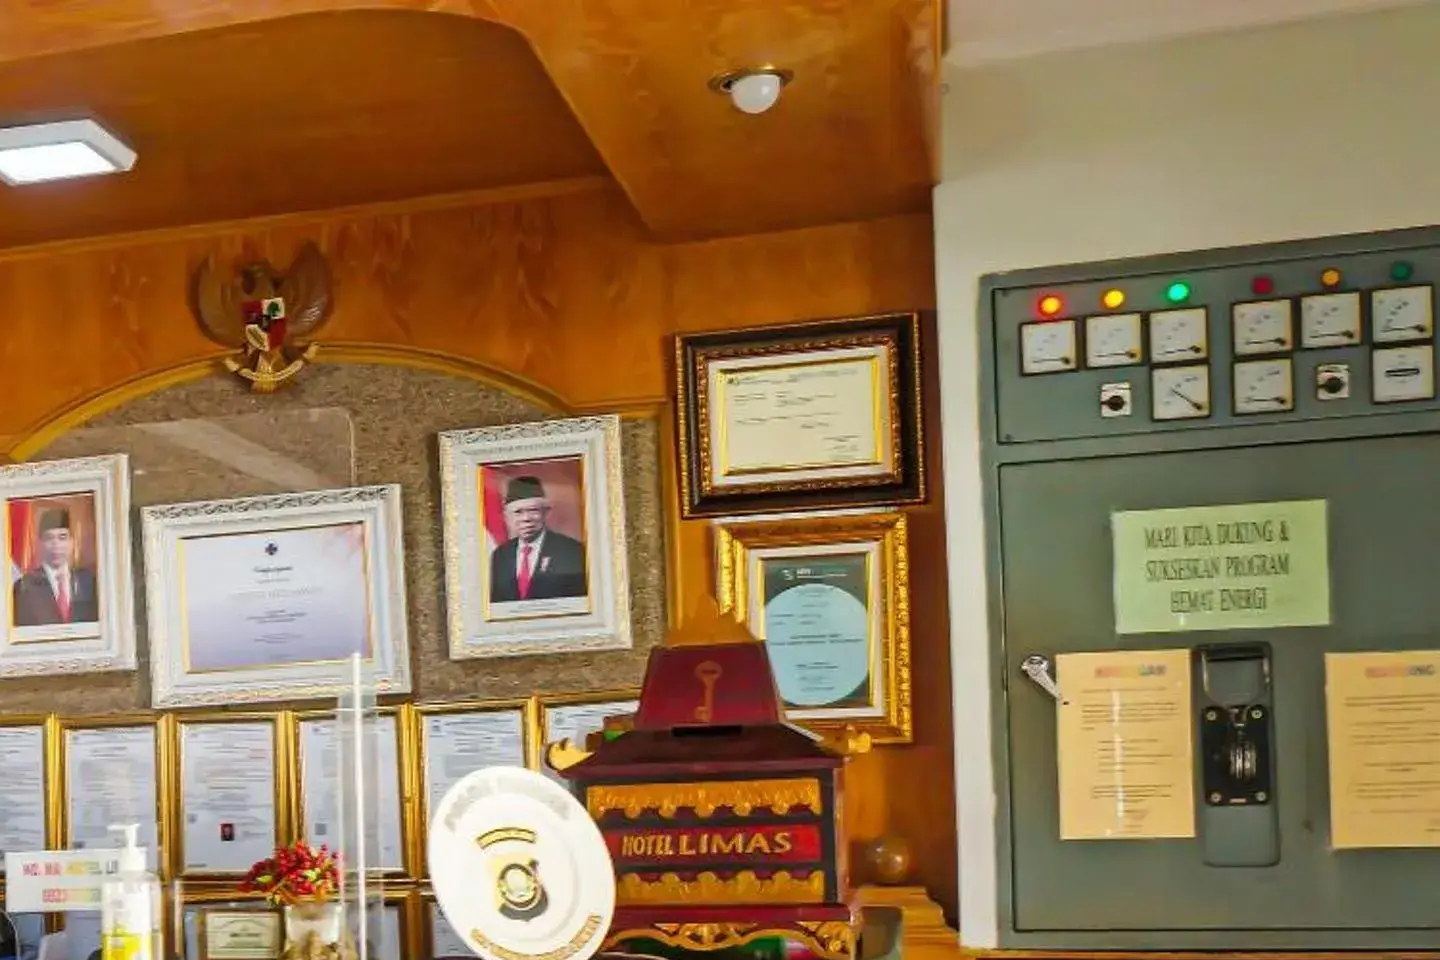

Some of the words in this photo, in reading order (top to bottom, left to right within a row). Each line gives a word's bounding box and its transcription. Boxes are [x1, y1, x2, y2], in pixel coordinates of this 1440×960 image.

[1144, 526, 1177, 548] MARI
[1183, 525, 1213, 546] KITA
[1217, 520, 1273, 545] DUKUNG
[1278, 520, 1290, 541] &
[1146, 557, 1221, 581] SUKSESKAN
[1225, 553, 1290, 577] PROGRAM
[1220, 586, 1267, 611] ENERGI
[622, 834, 674, 856] HOTEL
[679, 832, 793, 855] LIMAS
